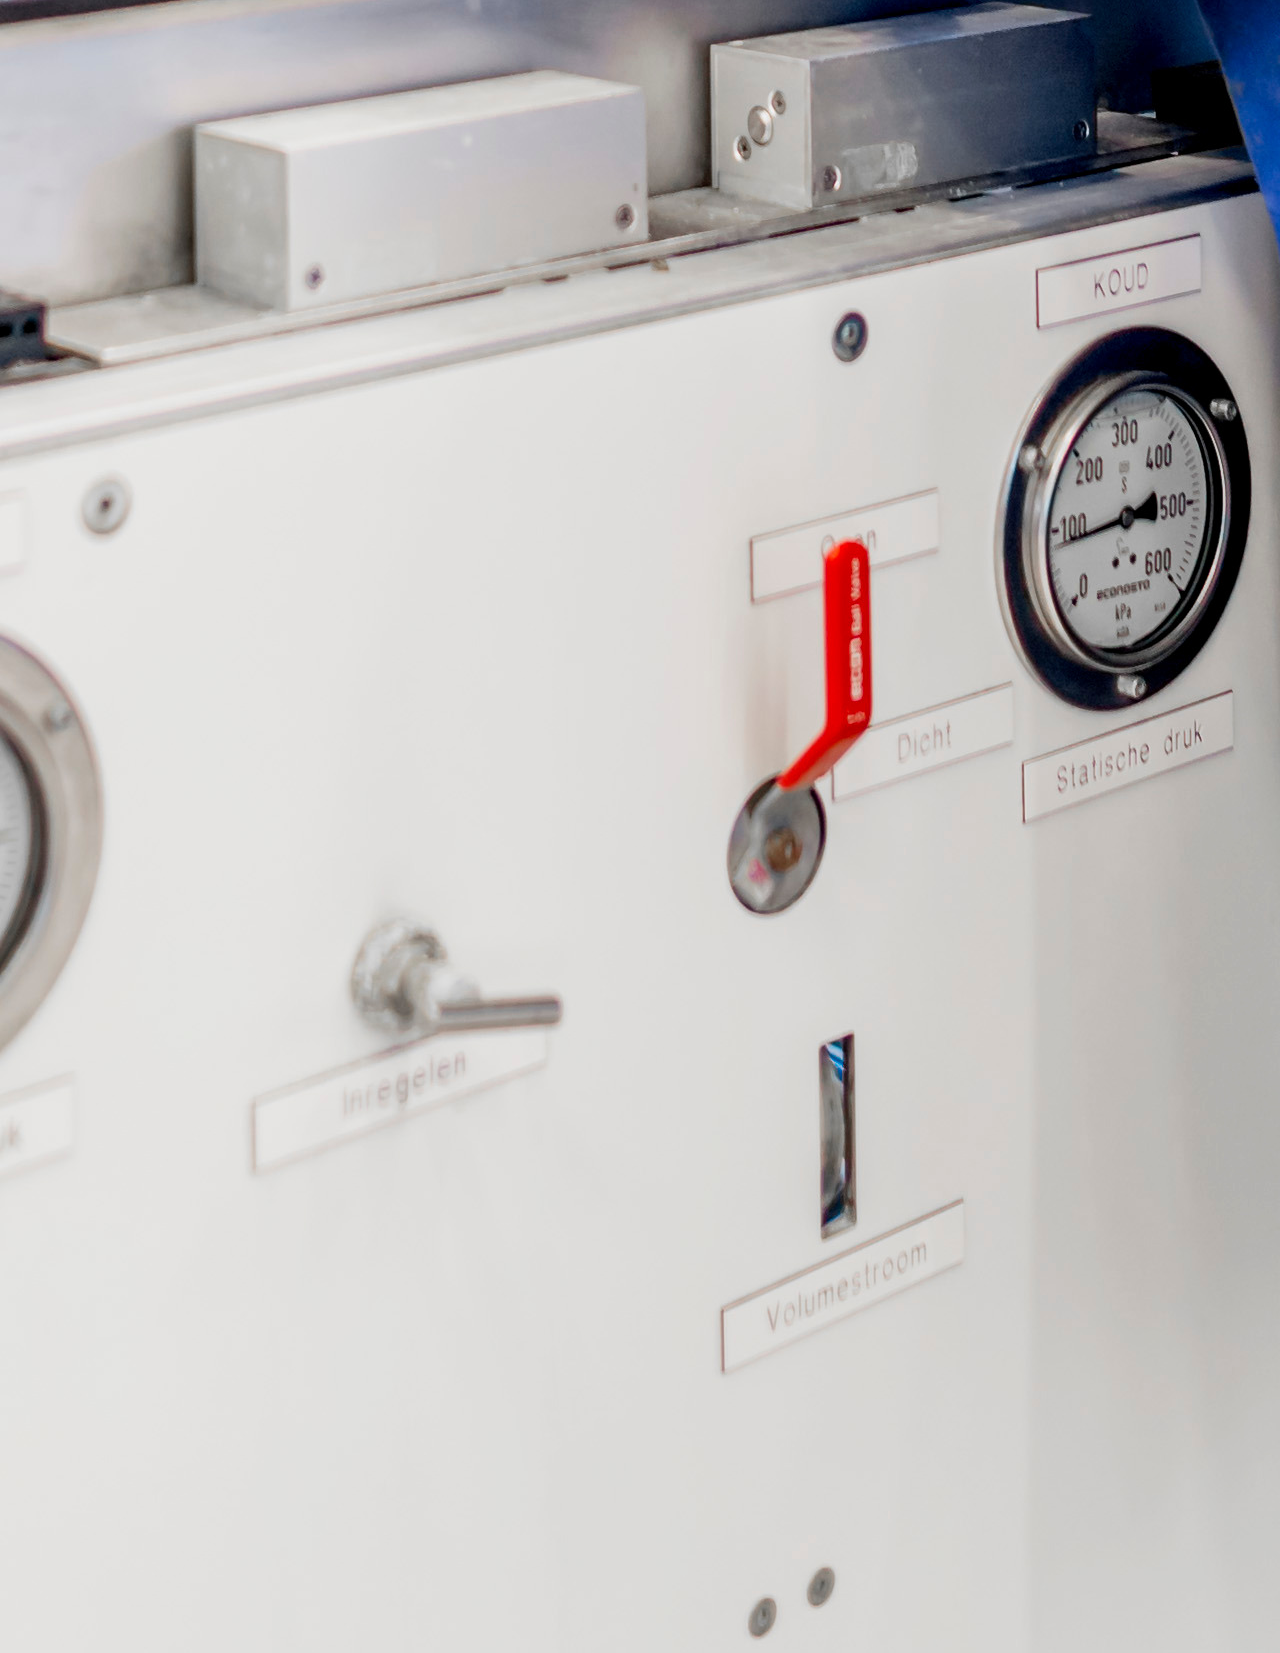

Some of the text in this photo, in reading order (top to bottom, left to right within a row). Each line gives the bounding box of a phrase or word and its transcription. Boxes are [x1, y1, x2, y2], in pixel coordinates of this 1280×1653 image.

[1094, 262, 1149, 298] KOUD
[1112, 419, 1138, 447] 300
[1076, 456, 1103, 485] 200
[1146, 443, 1172, 470] 400
[1160, 492, 1186, 520] 500
[1060, 512, 1087, 544] 100
[1145, 548, 1171, 576] 600
[1078, 573, 1088, 598] 0
[897, 720, 952, 764] Dicht
[1056, 720, 1203, 794] Statische druk
[342, 1051, 467, 1117] Inregelen
[767, 1242, 928, 1333] Volumestroom
